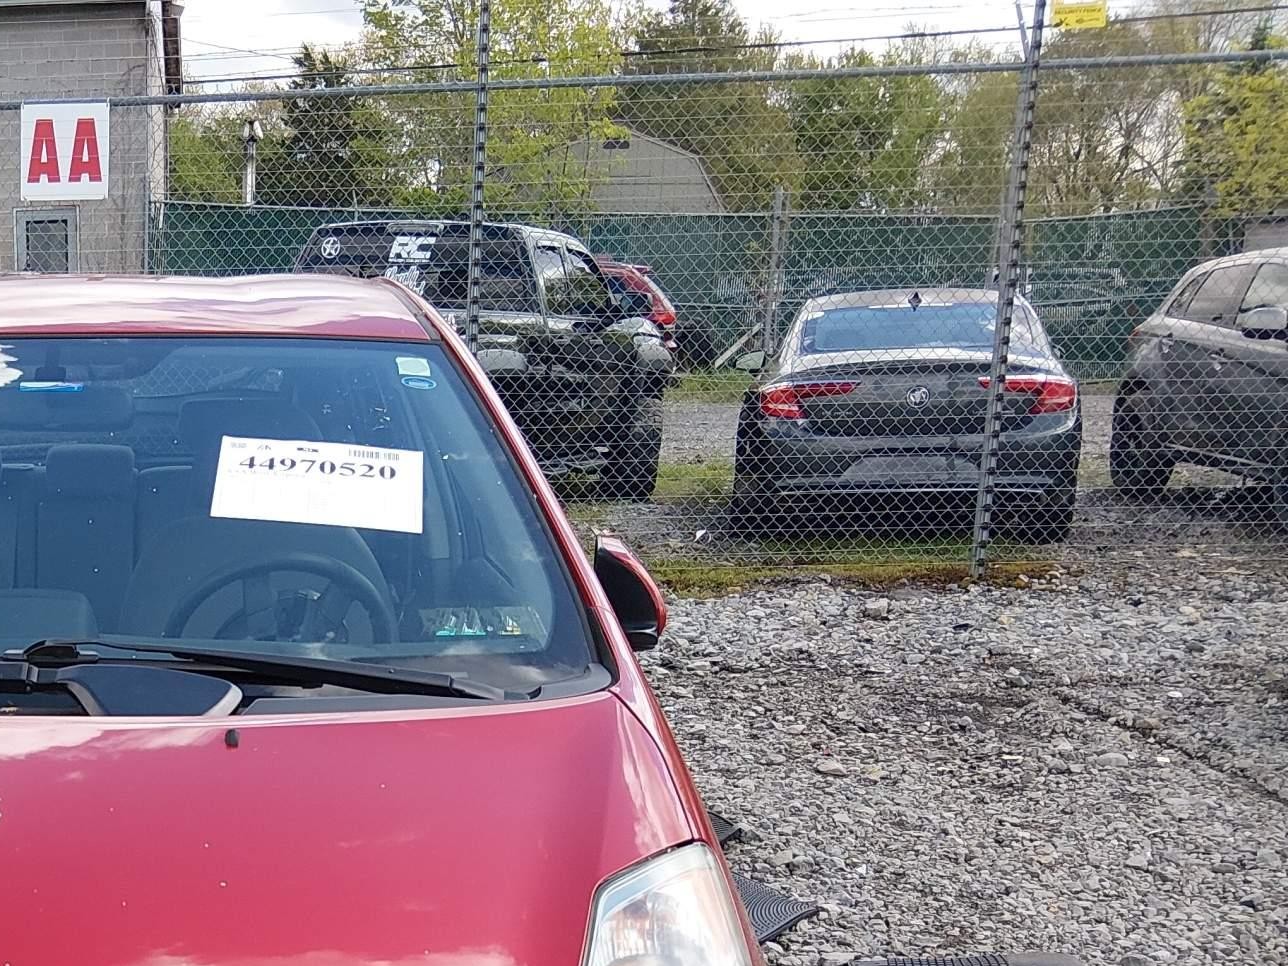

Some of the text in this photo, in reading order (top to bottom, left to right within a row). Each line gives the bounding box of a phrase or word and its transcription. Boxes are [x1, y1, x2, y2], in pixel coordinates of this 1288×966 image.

[27, 118, 102, 183] AA
[388, 236, 436, 259] RC
[239, 455, 396, 480] 44970520
